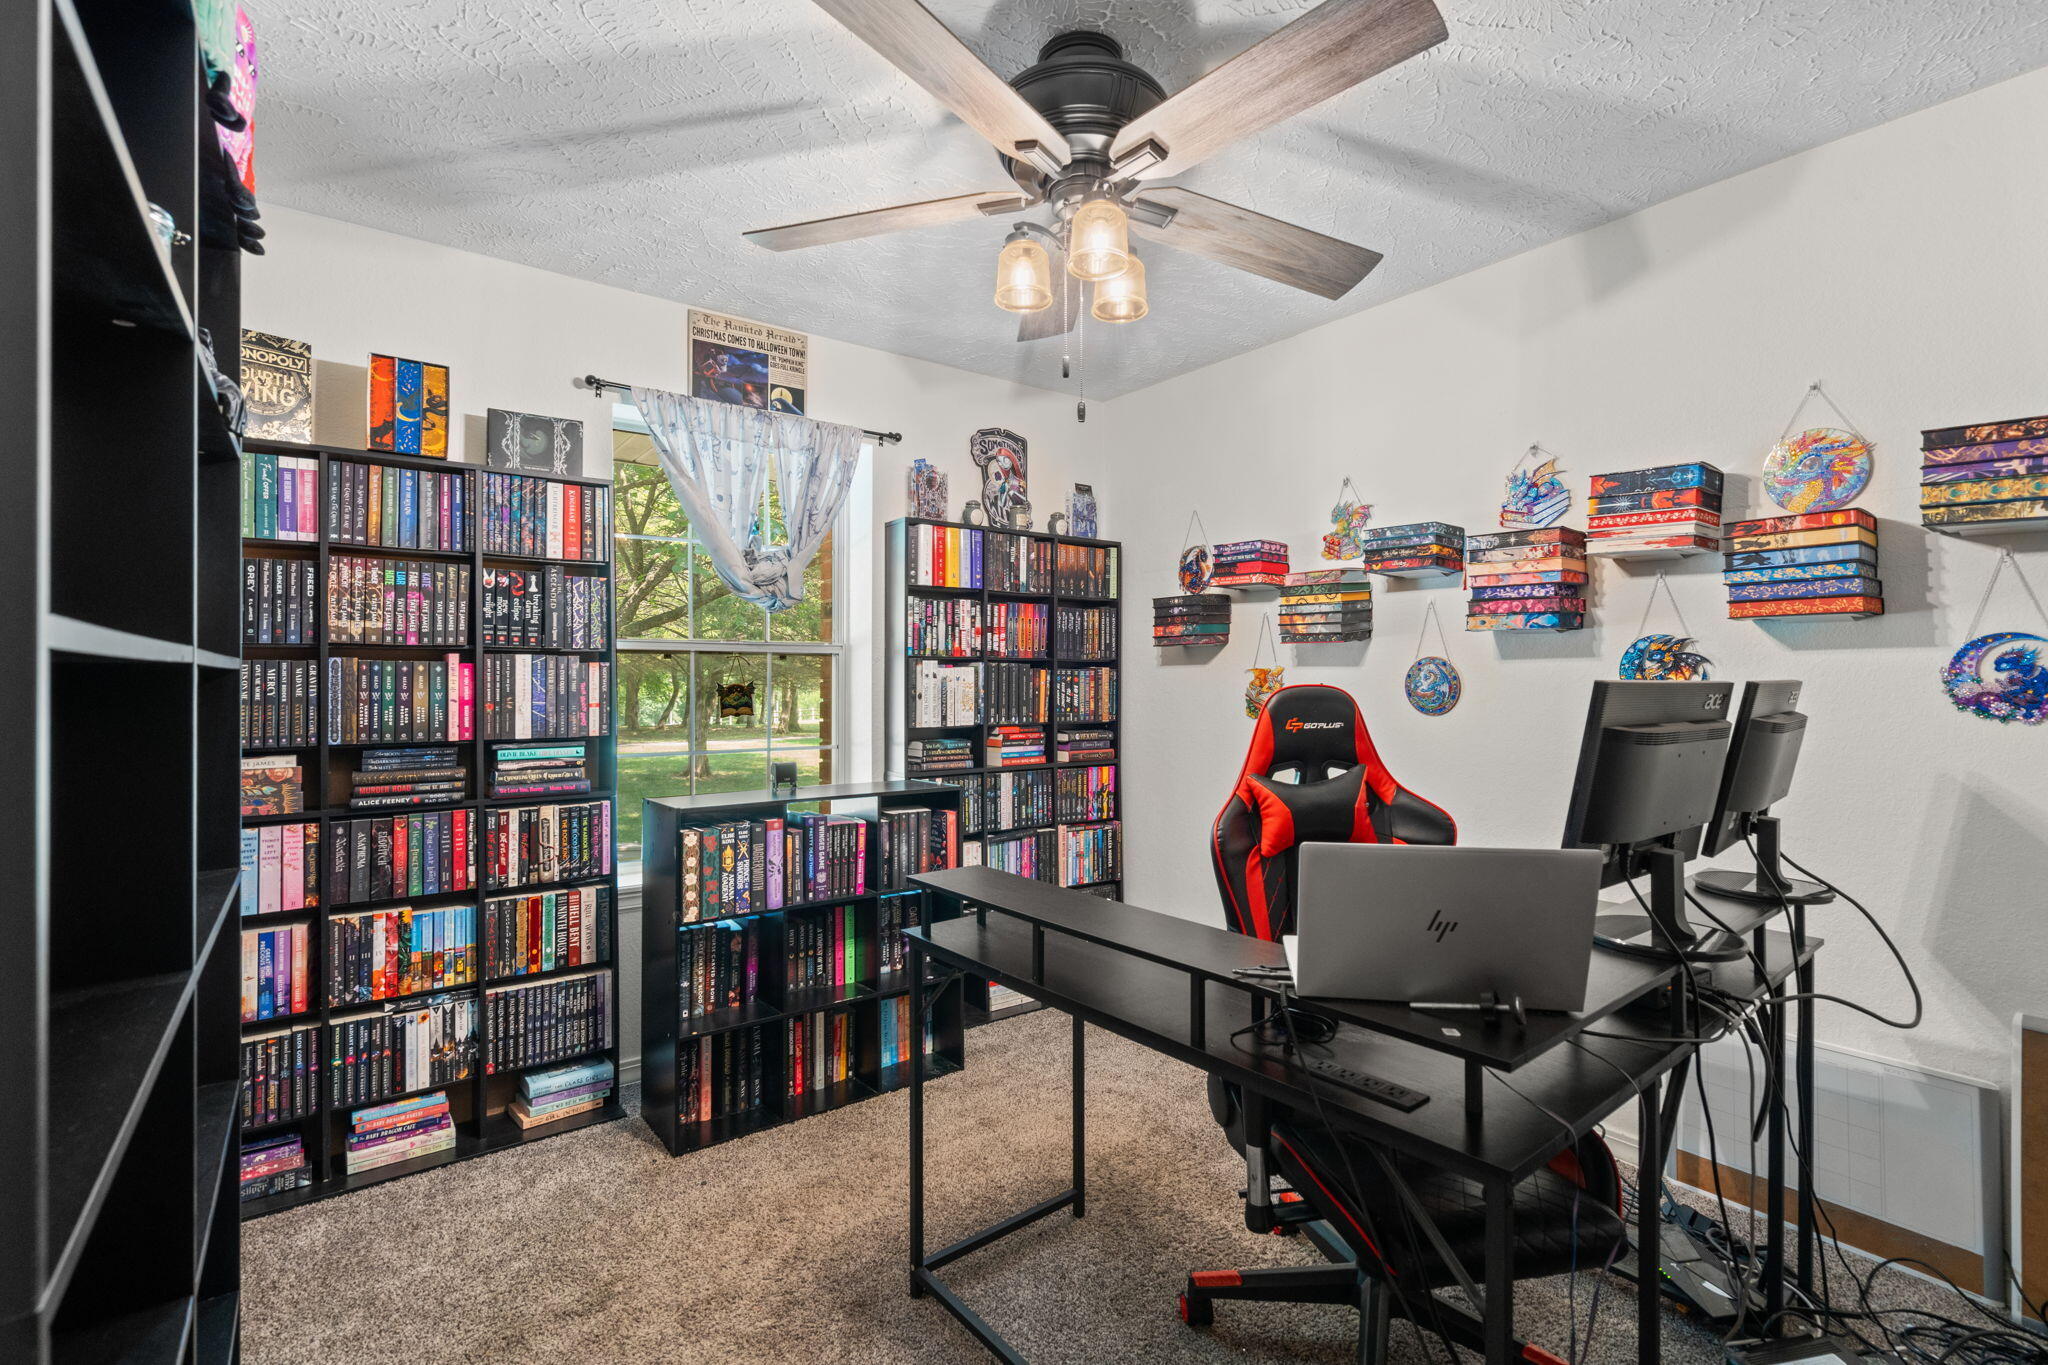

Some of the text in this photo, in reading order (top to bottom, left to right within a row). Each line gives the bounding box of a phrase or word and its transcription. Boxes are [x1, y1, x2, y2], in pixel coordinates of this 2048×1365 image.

[692, 326, 806, 360] CHRISTMAS COMES TO HALLOWEEN TOWN!
[703, 314, 796, 344] The Haunted Herald
[241, 366, 294, 388] OURTH
[247, 565, 255, 592] GREY
[385, 570, 394, 585] HATE
[396, 571, 406, 584] LIAR
[409, 571, 418, 586] FAKE
[422, 572, 431, 587] KATE
[396, 598, 404, 631] TATE JAMES
[408, 599, 416, 631] TATE JAMES
[483, 593, 494, 618] twilight
[532, 594, 541, 624] breaking
[267, 668, 276, 697] MERCY
[359, 786, 389, 794] MURDER
[357, 832, 366, 869] ANATHEMA
[378, 831, 387, 866] ELDRITCH
[752, 844, 764, 891] DAGGERMOUTH
[557, 906, 567, 957] NINTH HOUSE
[570, 905, 579, 946] HELL BENT
[1426, 910, 1458, 943] hp
[380, 1127, 403, 1136] DRAGON
